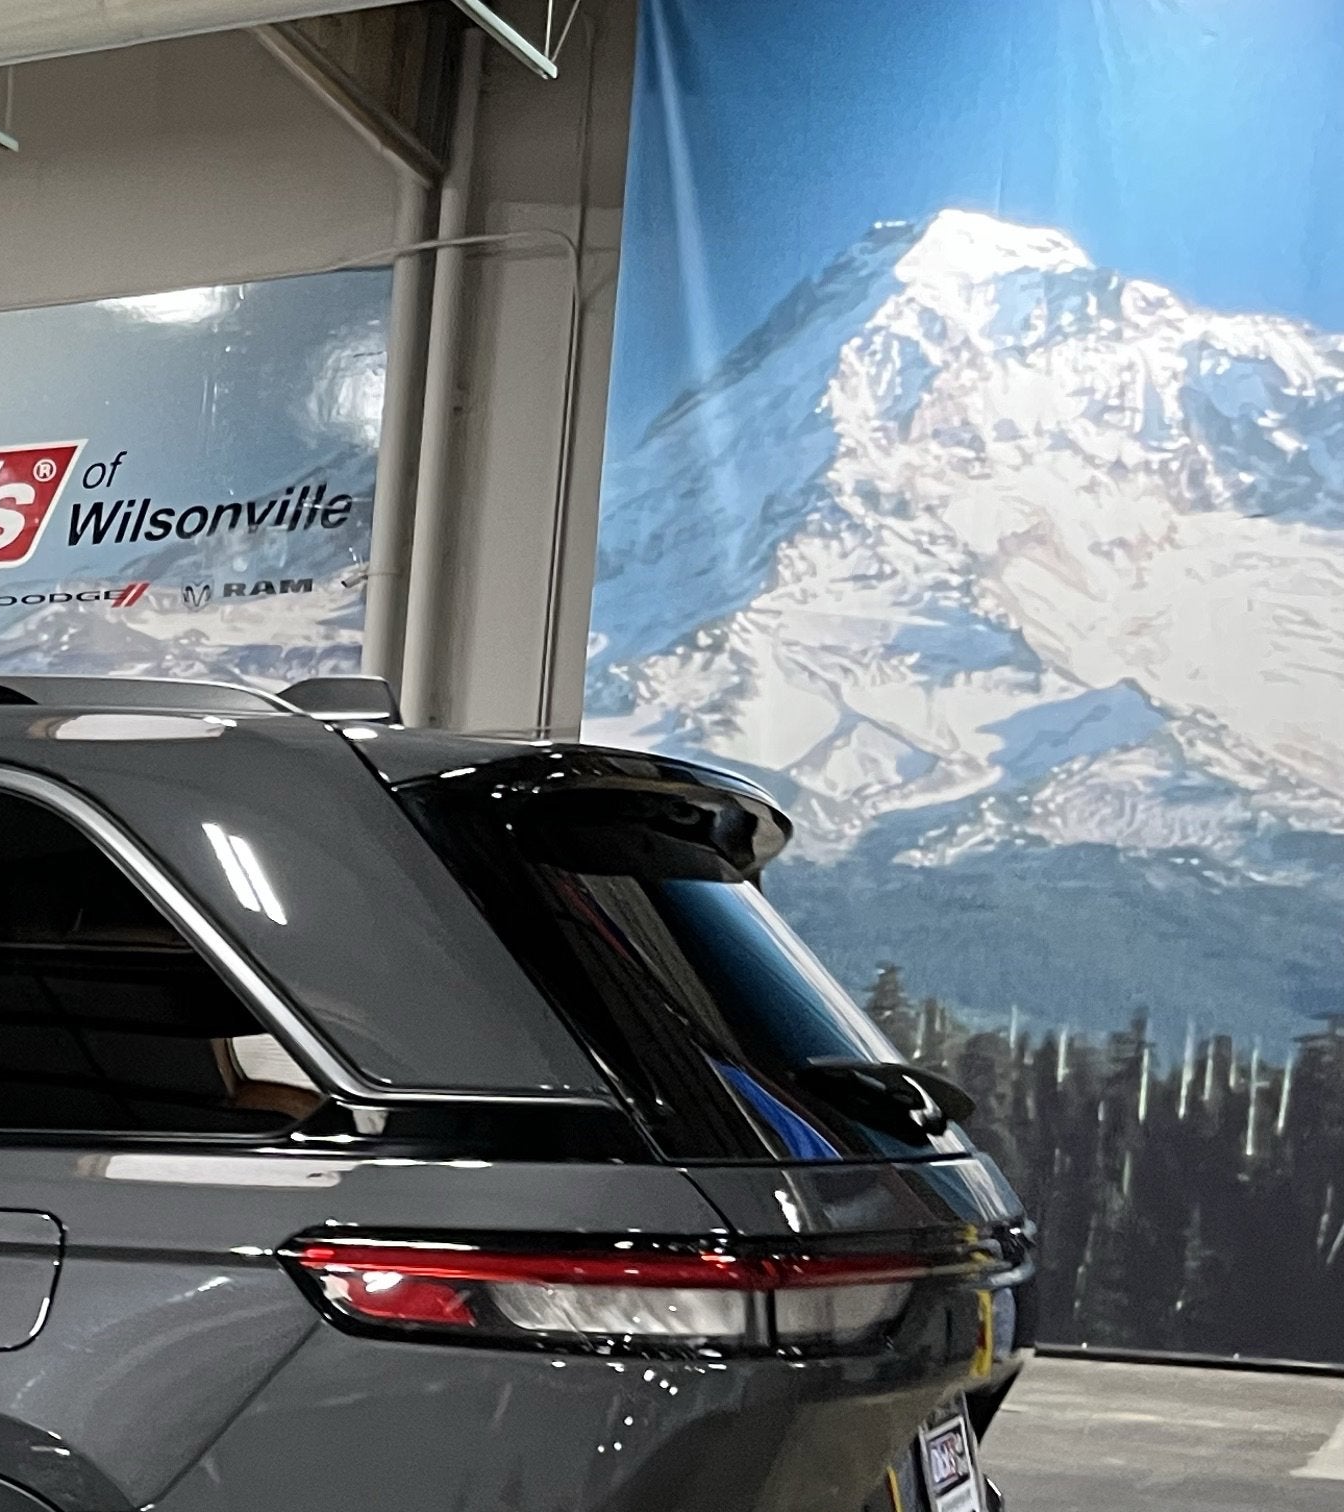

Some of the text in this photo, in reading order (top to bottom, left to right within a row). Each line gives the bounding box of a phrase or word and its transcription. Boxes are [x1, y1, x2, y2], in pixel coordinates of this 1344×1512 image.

[82, 450, 128, 489] of
[67, 481, 353, 546] Wilsonville
[223, 578, 313, 598] RAM
